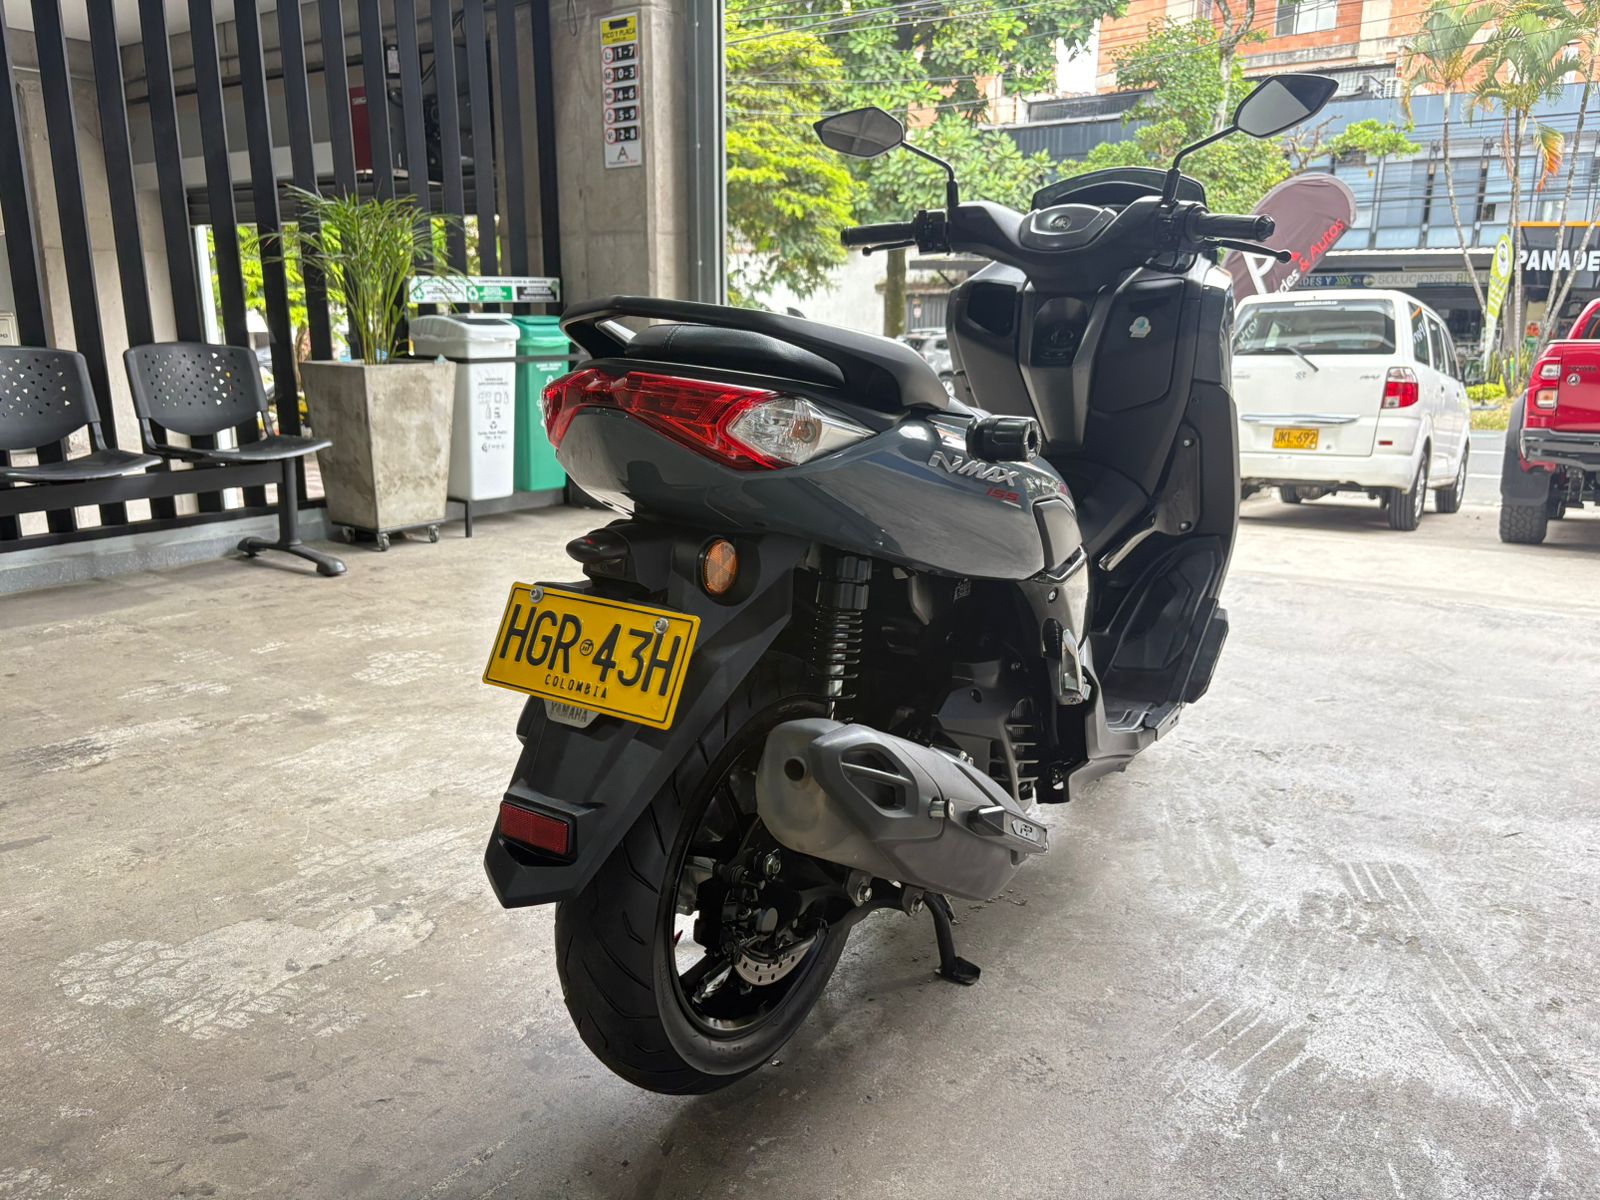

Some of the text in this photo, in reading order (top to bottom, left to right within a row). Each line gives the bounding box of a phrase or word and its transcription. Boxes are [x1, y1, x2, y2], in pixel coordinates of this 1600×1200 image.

[1311, 218, 1345, 261] Autos
[1377, 272, 1453, 284] SOLUCIONES
[928, 450, 1019, 487] NMAX
[986, 486, 1021, 502] 155
[499, 603, 682, 697] HGR 43H
[544, 673, 608, 700] COLOMBIA
